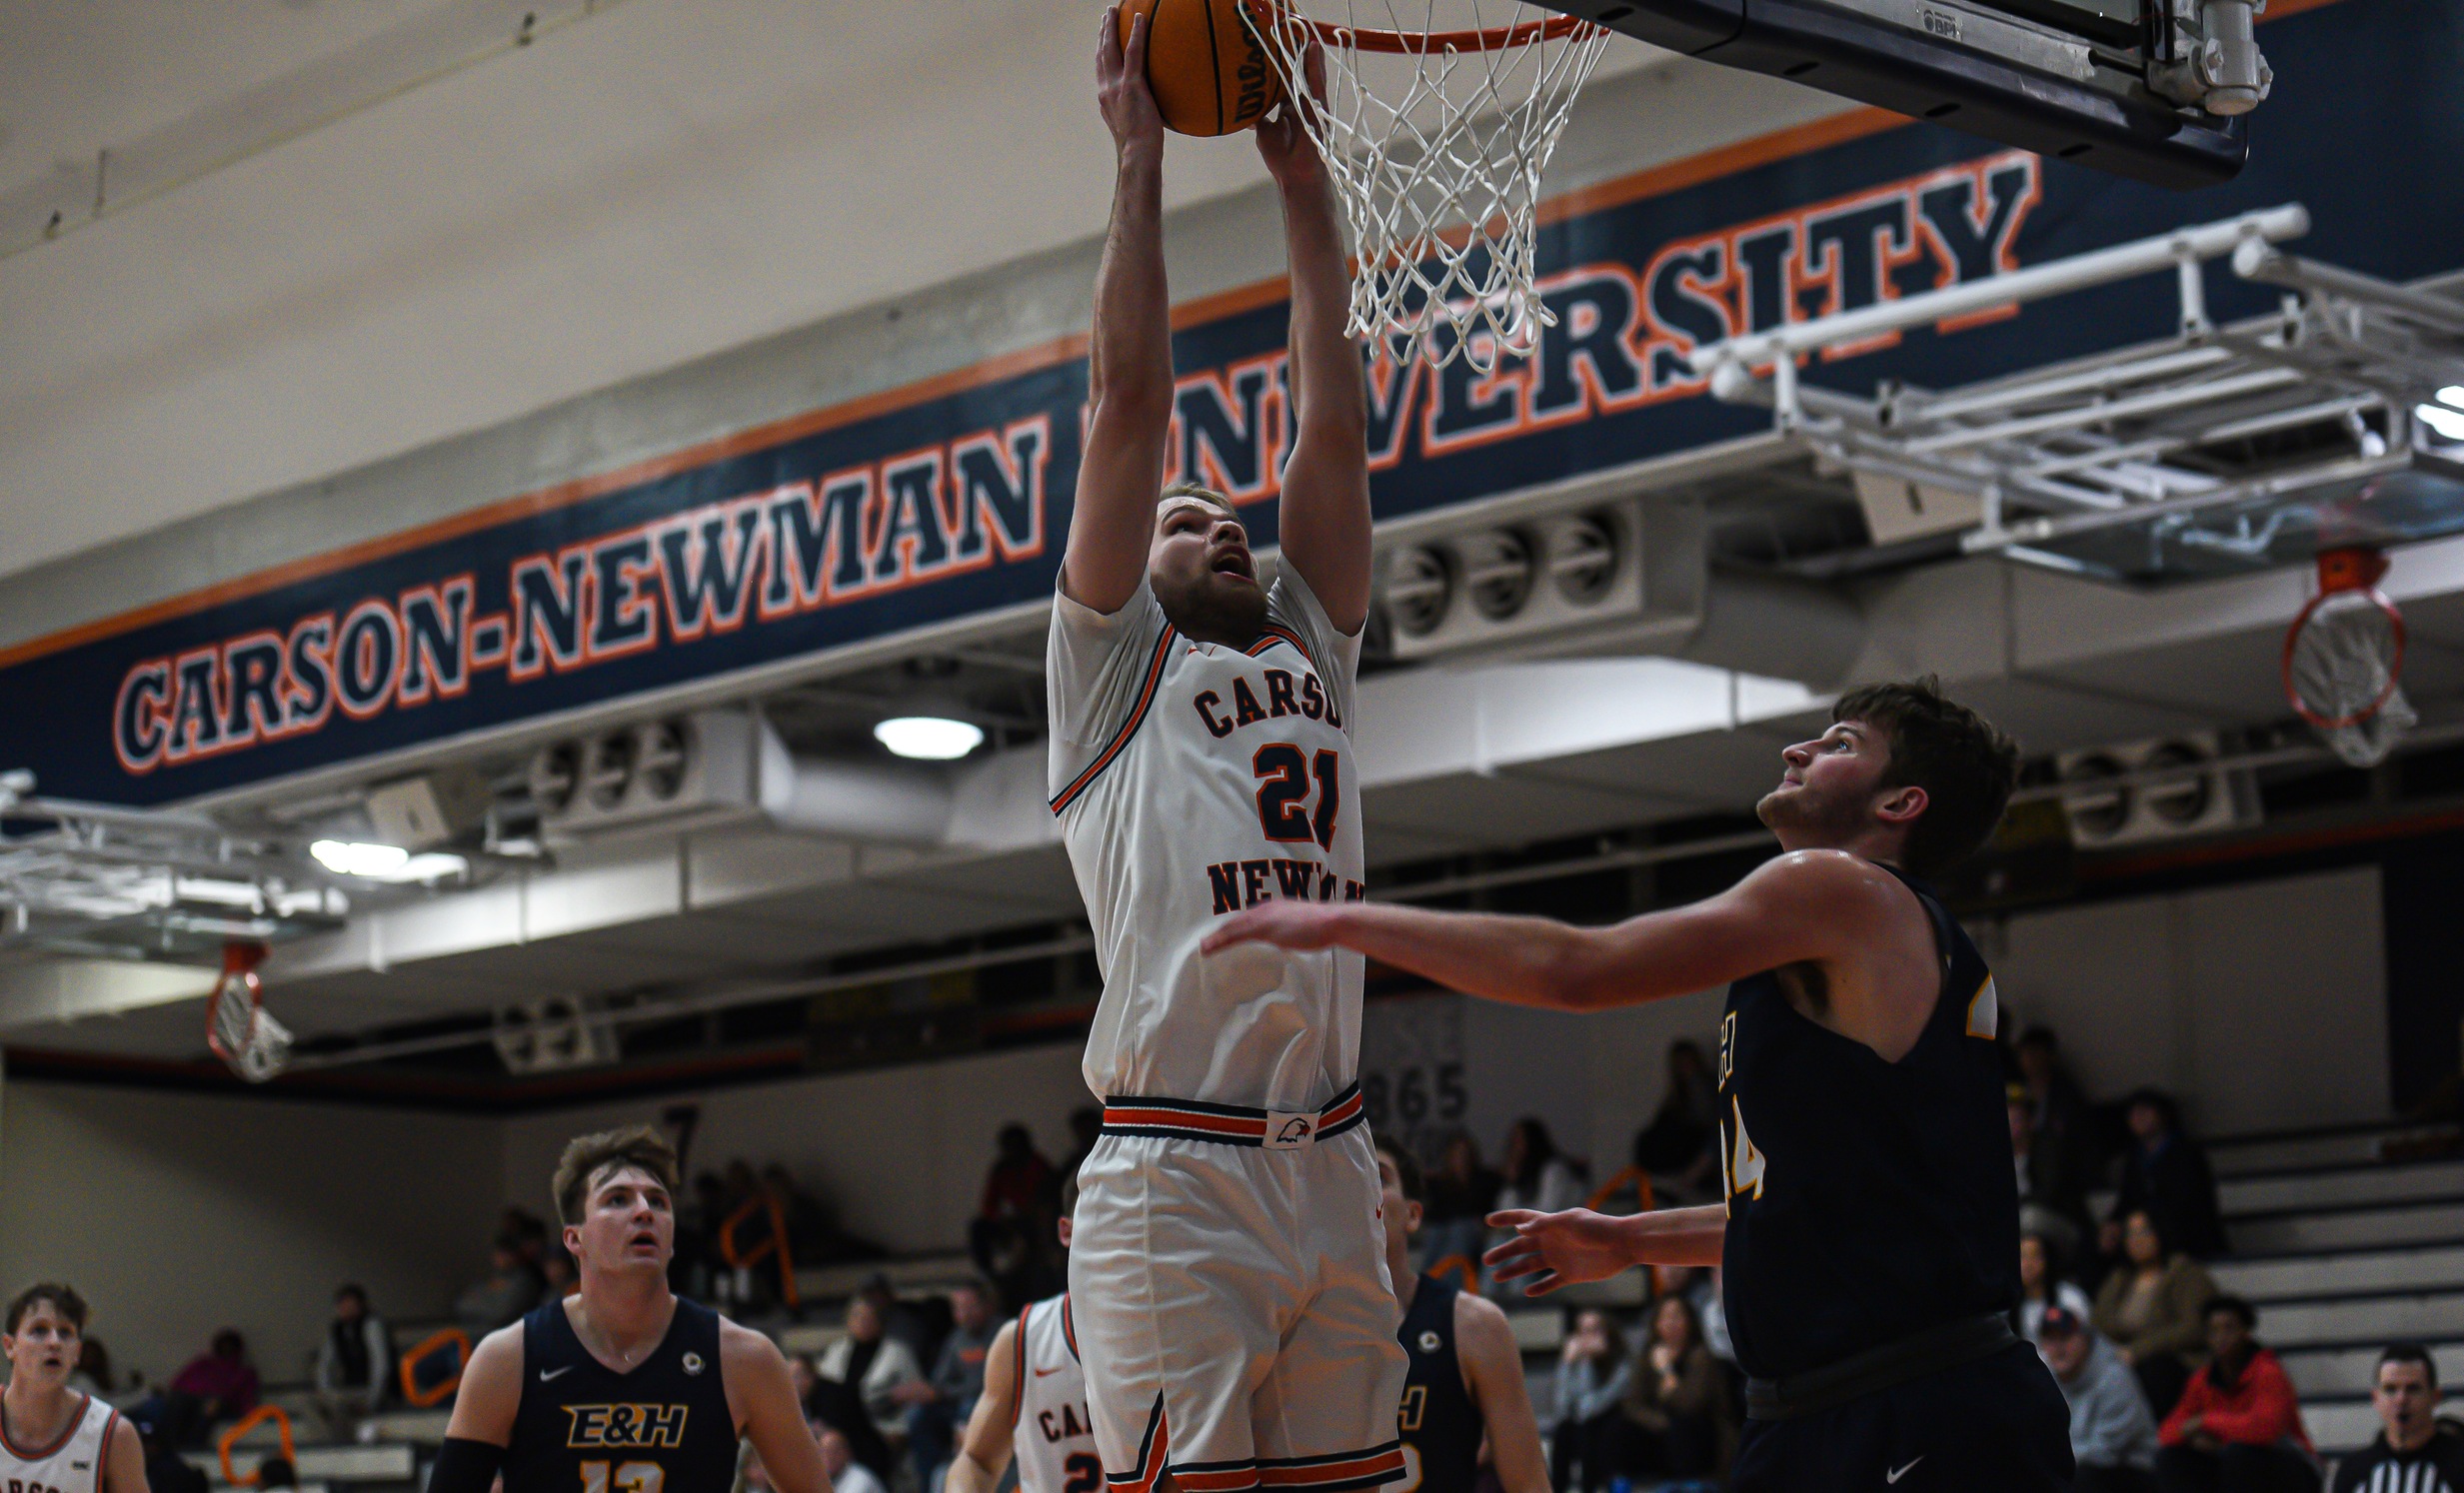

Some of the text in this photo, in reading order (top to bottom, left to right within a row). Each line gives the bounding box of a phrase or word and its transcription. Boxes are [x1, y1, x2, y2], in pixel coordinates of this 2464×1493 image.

[112, 150, 2042, 775] CARSON-NEWMAN NVERSITY
[1252, 743, 1339, 852] 21
[560, 1402, 690, 1448] E&H
